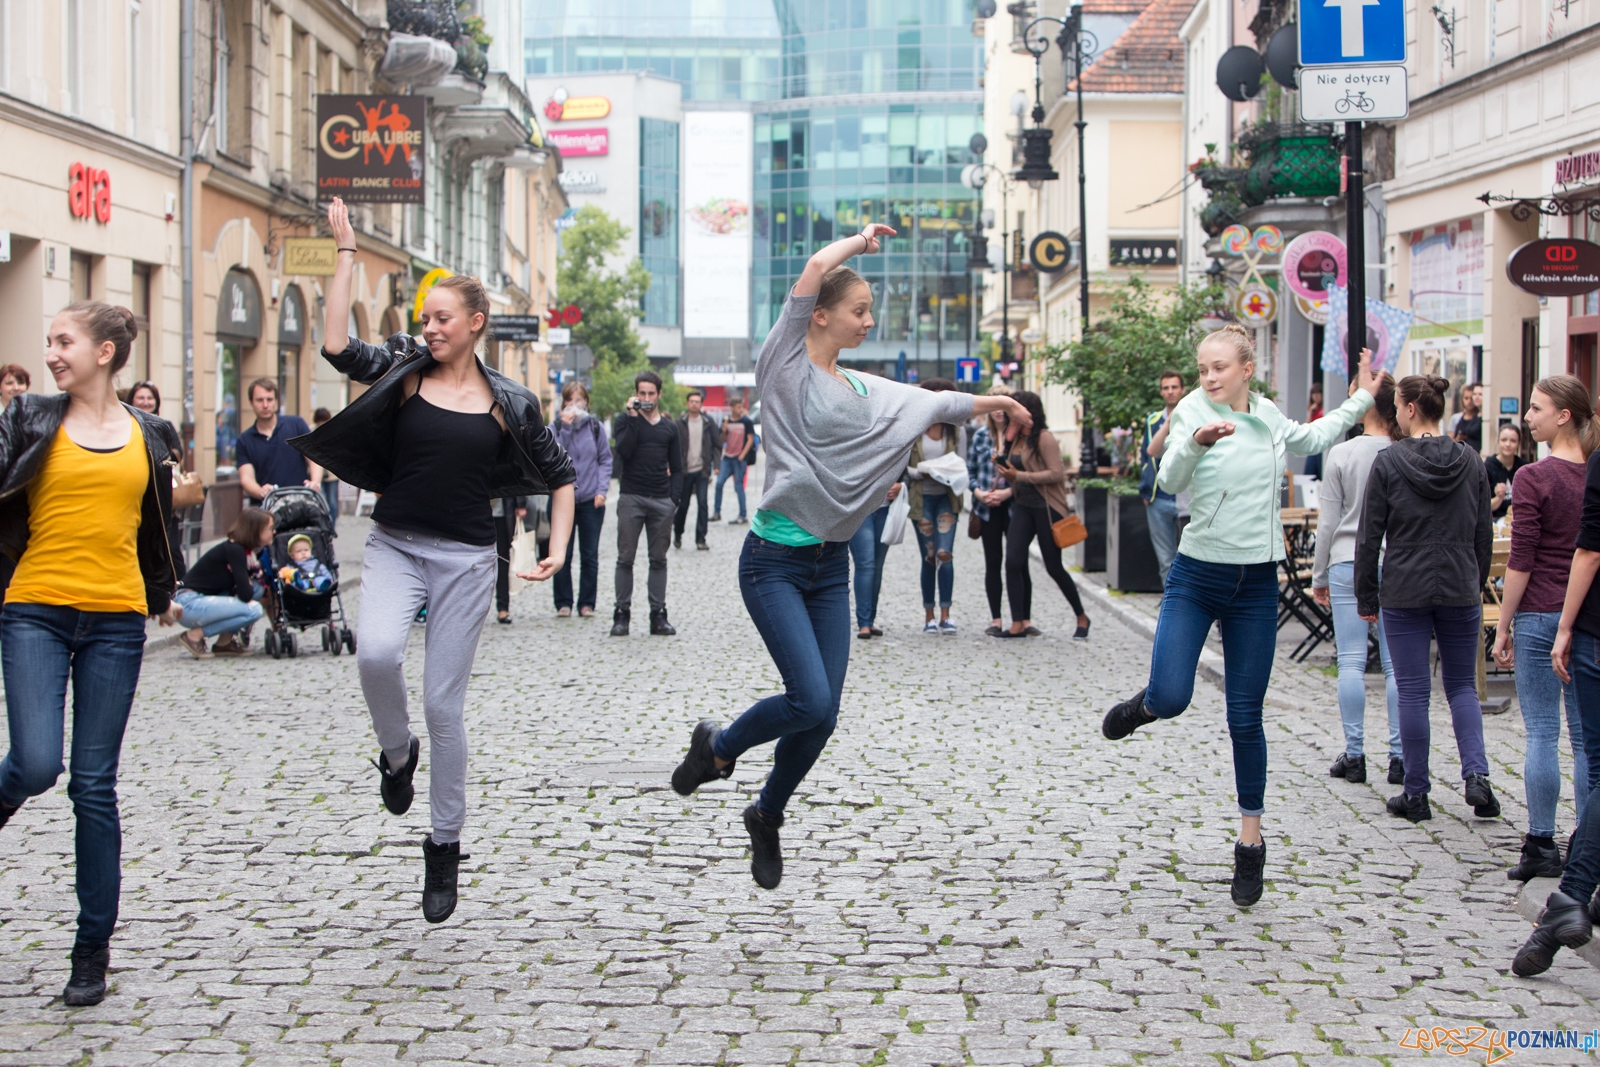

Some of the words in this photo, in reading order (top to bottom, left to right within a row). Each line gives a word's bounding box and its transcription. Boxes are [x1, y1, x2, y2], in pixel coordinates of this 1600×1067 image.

[1317, 74, 1337, 84] Nie
[1345, 74, 1390, 85] dotyczy
[384, 130, 422, 144] LIBRE
[319, 177, 350, 187] LATIN
[352, 177, 390, 188] DANCE
[391, 177, 421, 187] CLUB
[69, 162, 111, 223] ara
[1121, 246, 1163, 259] KLUB
[1562, 273, 1599, 283] autorska
